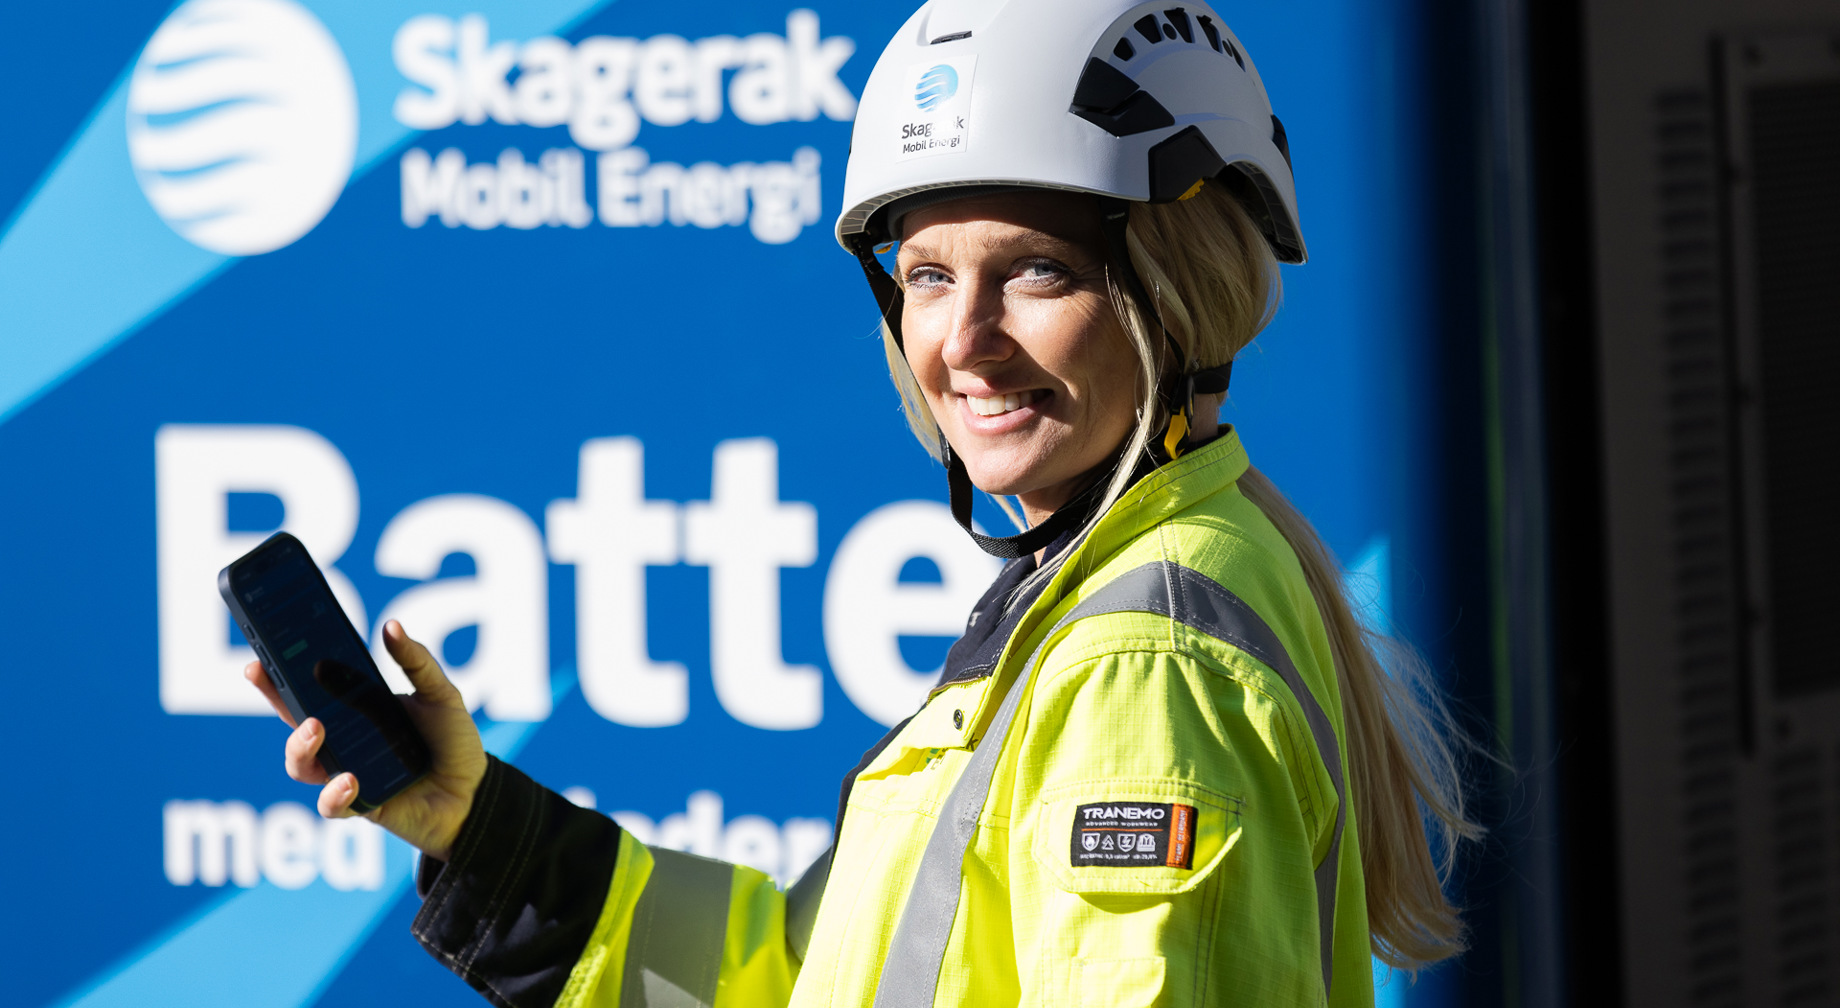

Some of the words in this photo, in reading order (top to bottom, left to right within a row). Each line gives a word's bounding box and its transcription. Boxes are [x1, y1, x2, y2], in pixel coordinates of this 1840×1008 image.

[394, 10, 858, 150] Skagerak
[902, 116, 964, 139] Skagk
[903, 140, 927, 154] Mobil
[401, 150, 590, 230] Mobil
[600, 150, 822, 245] Energi
[1083, 807, 1165, 820] TRANEMO
